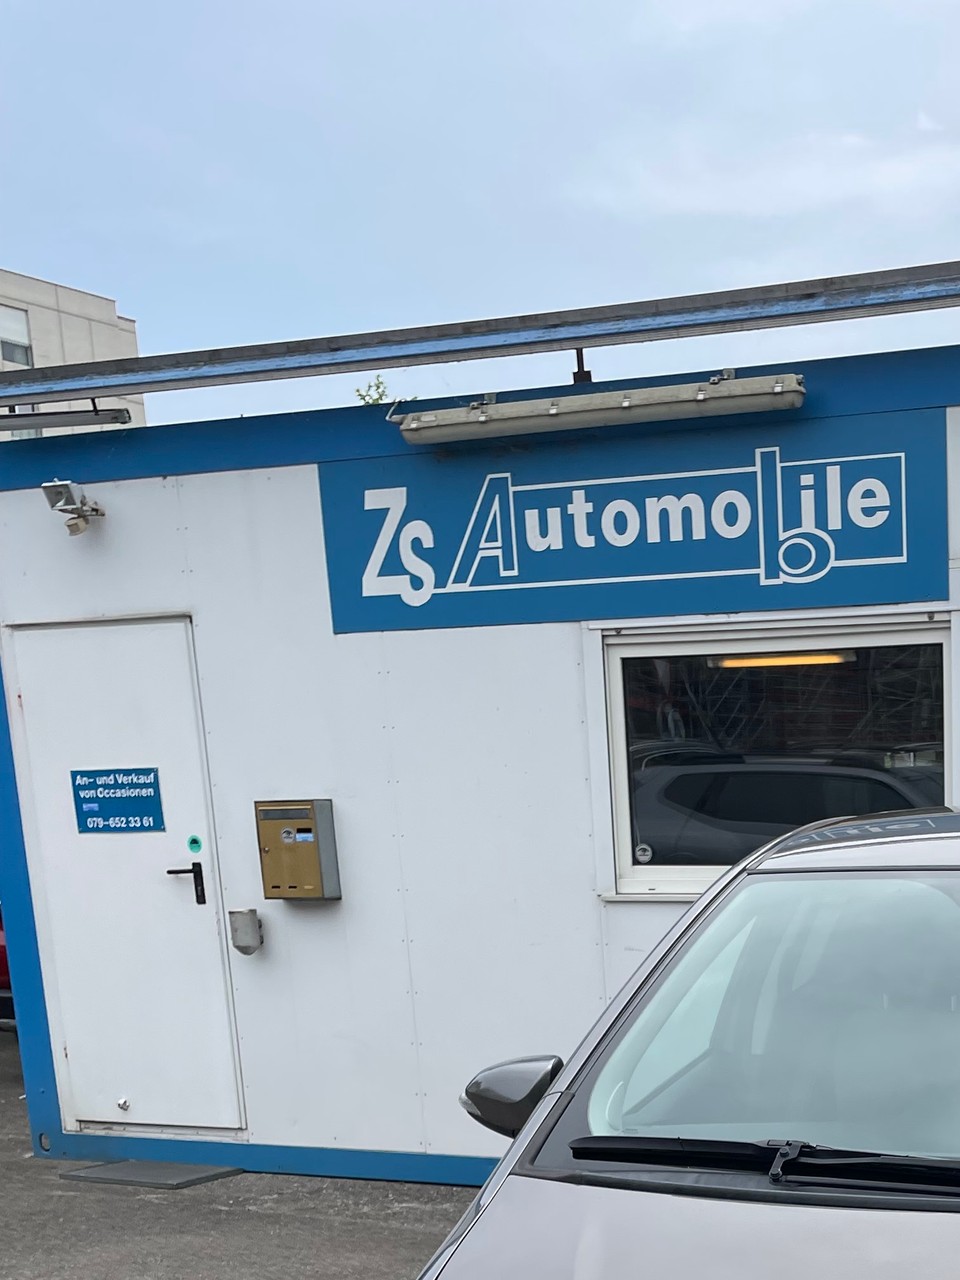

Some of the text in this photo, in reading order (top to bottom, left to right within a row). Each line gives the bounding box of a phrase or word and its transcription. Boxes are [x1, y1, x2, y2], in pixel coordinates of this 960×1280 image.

[446, 447, 891, 588] Automobile
[76, 772, 154, 785] An- und Verkauf
[79, 786, 154, 798] von Occasionen
[86, 816, 154, 828] 079-652 33 61
